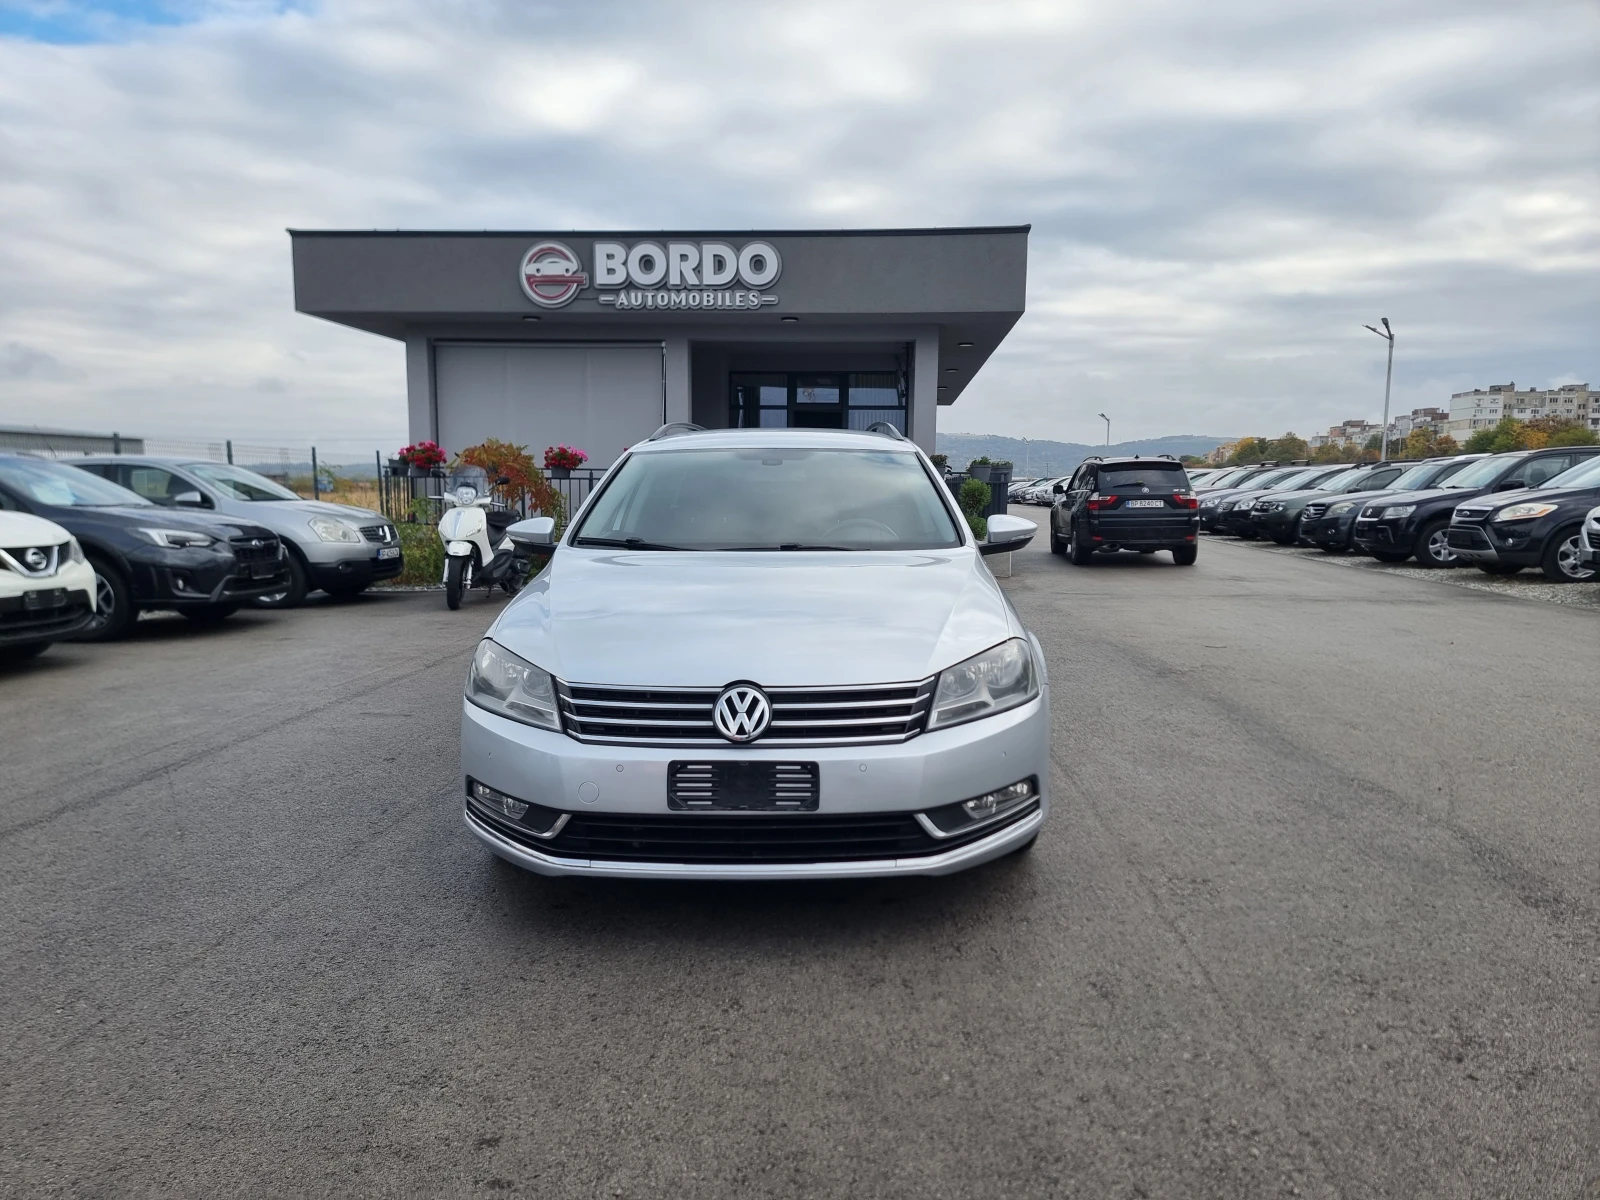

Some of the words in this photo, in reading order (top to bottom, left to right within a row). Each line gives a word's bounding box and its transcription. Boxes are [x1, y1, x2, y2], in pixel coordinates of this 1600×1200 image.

[595, 243, 779, 286] BORDO
[616, 291, 760, 307] AUTOMOBILES
[715, 687, 769, 740] VW
